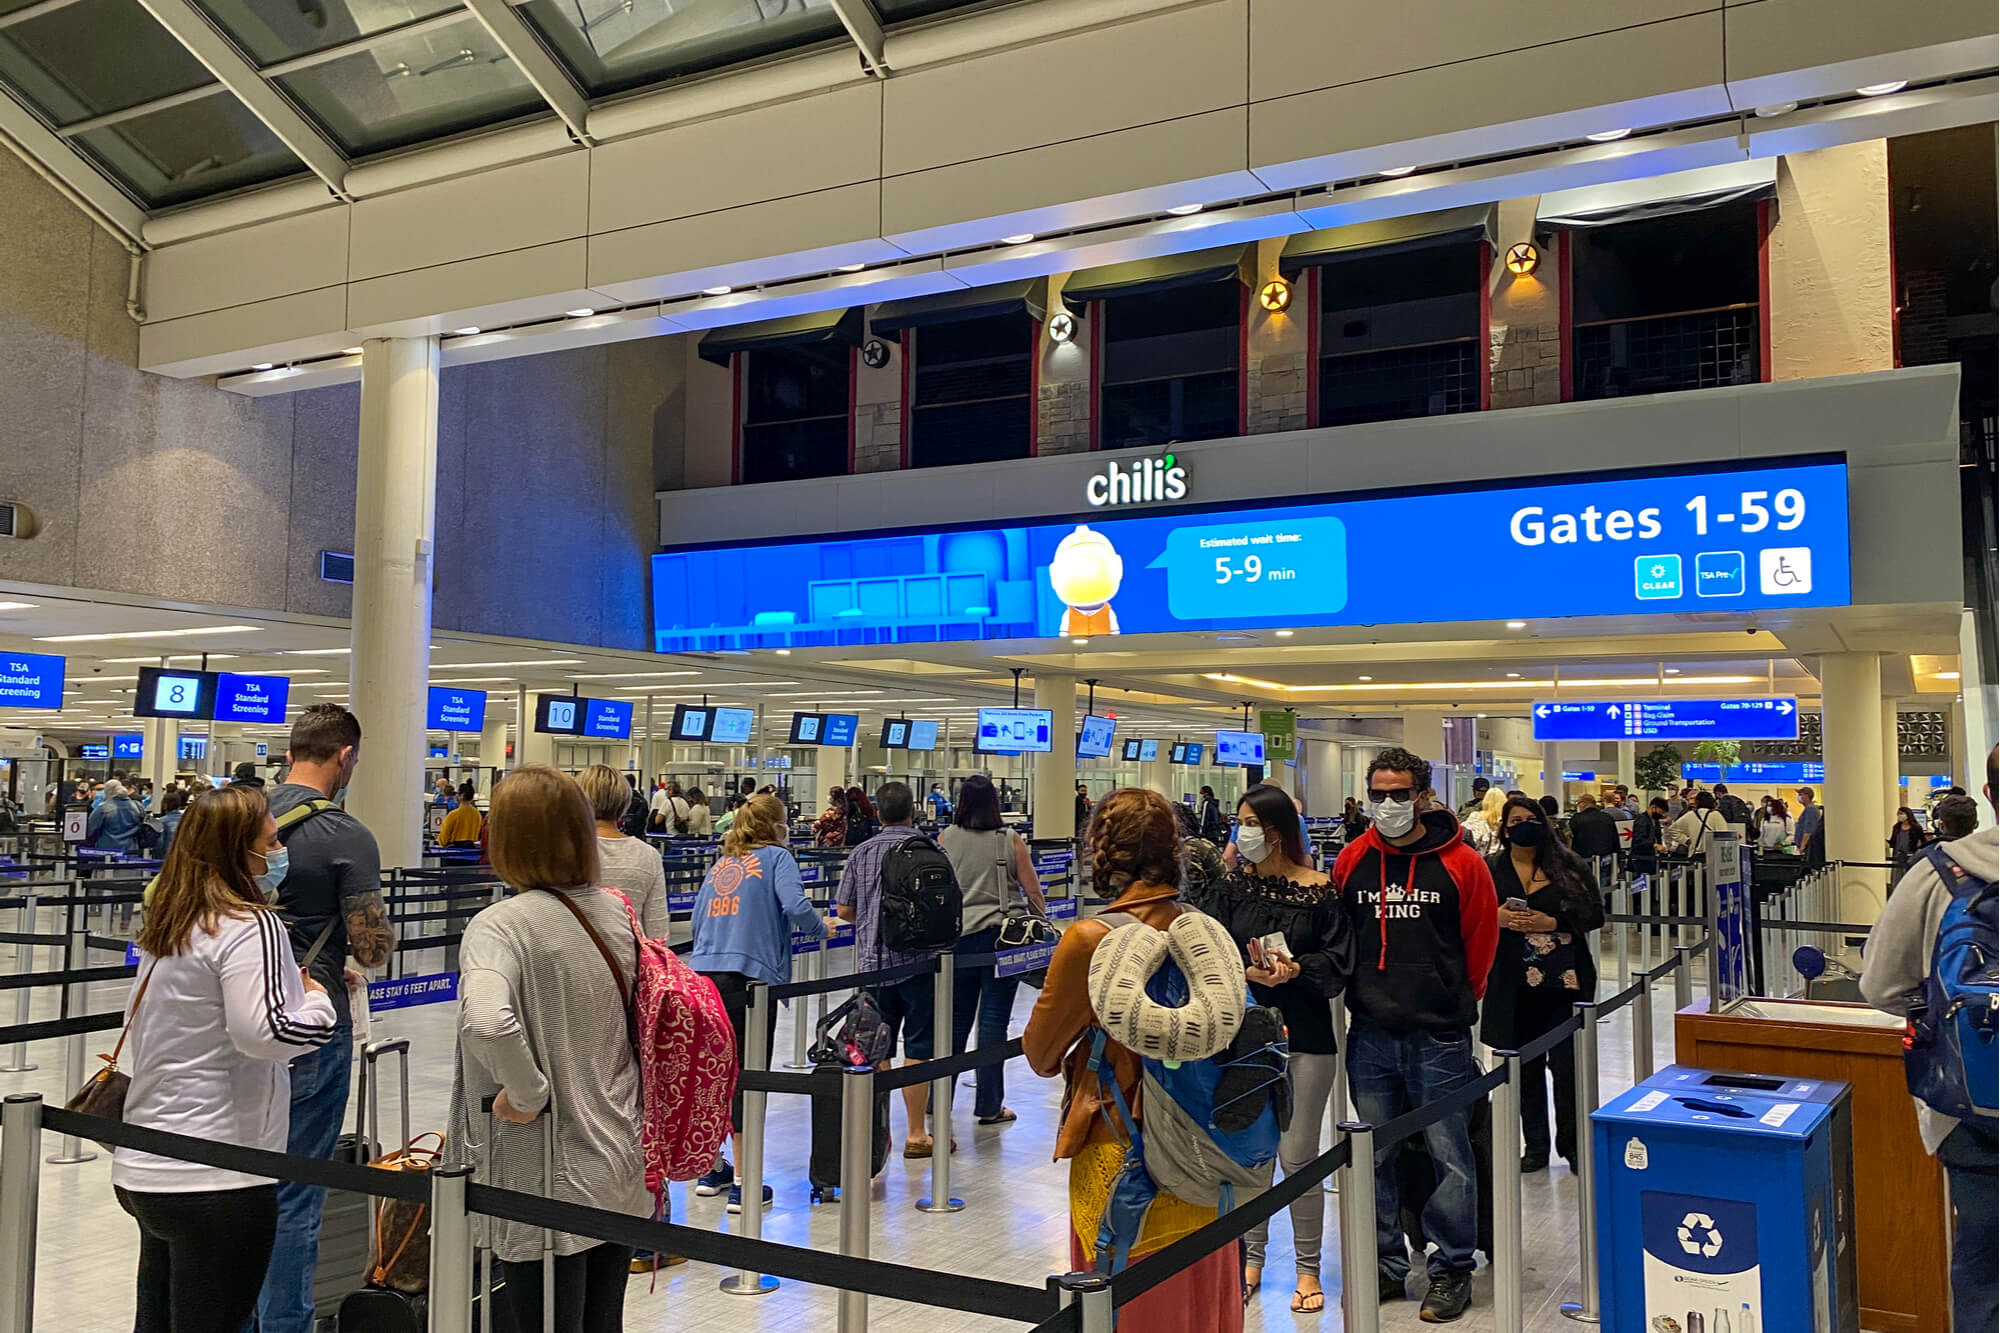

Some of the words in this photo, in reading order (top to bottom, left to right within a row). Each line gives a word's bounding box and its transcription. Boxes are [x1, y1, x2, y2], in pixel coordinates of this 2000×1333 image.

[1087, 454, 1187, 506] chili's
[1509, 505, 1662, 546] Gates
[1685, 488, 1806, 535] 1-59
[1200, 536, 1248, 549] Estimated
[1250, 534, 1274, 545] wait
[1276, 532, 1302, 544] time:
[1215, 554, 1262, 584] 5-9
[1268, 567, 1296, 581] min
[1642, 581, 1675, 590] CLEAR
[9, 662, 29, 672] TSA
[0, 687, 41, 699] creening
[169, 684, 185, 703] 8
[246, 683, 261, 692] TSA
[234, 693, 269, 704] Standard
[232, 703, 269, 716] Screening
[552, 707, 571, 723] 10
[686, 716, 701, 731] 11
[802, 721, 816, 735] 12
[1358, 890, 1380, 904] I'M
[1406, 888, 1440, 904] HER
[707, 895, 740, 918] 1986
[1375, 904, 1420, 918] KING
[386, 985, 404, 997] STAY
[404, 984, 409, 995] 6
[410, 981, 428, 994] FEET
[428, 978, 452, 991] APART.
